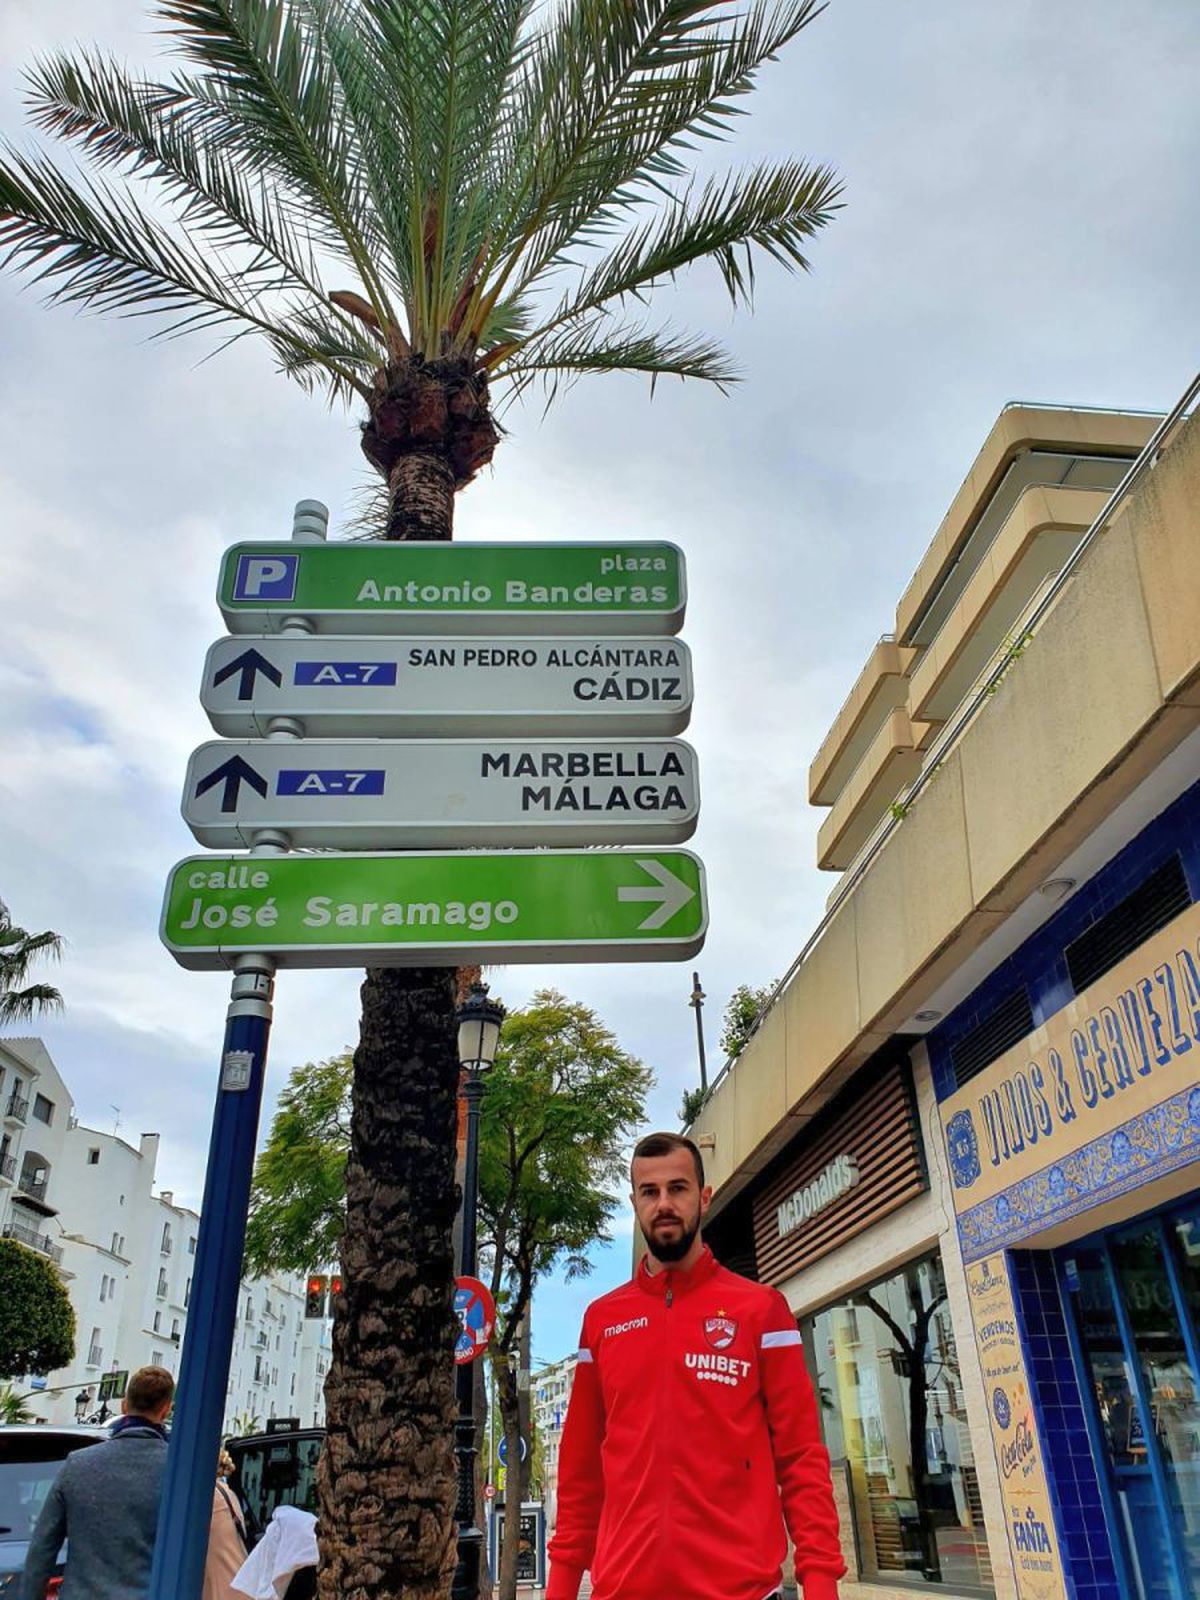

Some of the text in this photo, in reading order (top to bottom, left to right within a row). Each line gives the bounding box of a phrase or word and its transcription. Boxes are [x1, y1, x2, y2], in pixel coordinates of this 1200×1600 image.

[600, 554, 667, 575] plaza
[243, 560, 288, 596] P
[356, 579, 669, 604] Antonio Banderas
[408, 644, 680, 667] SAN PEDRO ALCÁNTARA
[313, 665, 378, 684] A-7
[572, 671, 682, 701] CÁDIZ
[481, 752, 685, 778] MARBELLA
[296, 773, 365, 793] A-7
[522, 776, 687, 811] MÁLAGA
[188, 865, 270, 891] calle
[180, 896, 520, 932] José Saramago
[978, 1061, 1054, 1166] VINOS
[1047, 1047, 1078, 1125] &
[1069, 937, 1200, 1110] CERVEZA
[776, 1153, 856, 1238] McDonald's
[604, 1316, 649, 1339] macron
[684, 1353, 752, 1378] UNIBET
[1012, 1521, 1053, 1554] FANTA
